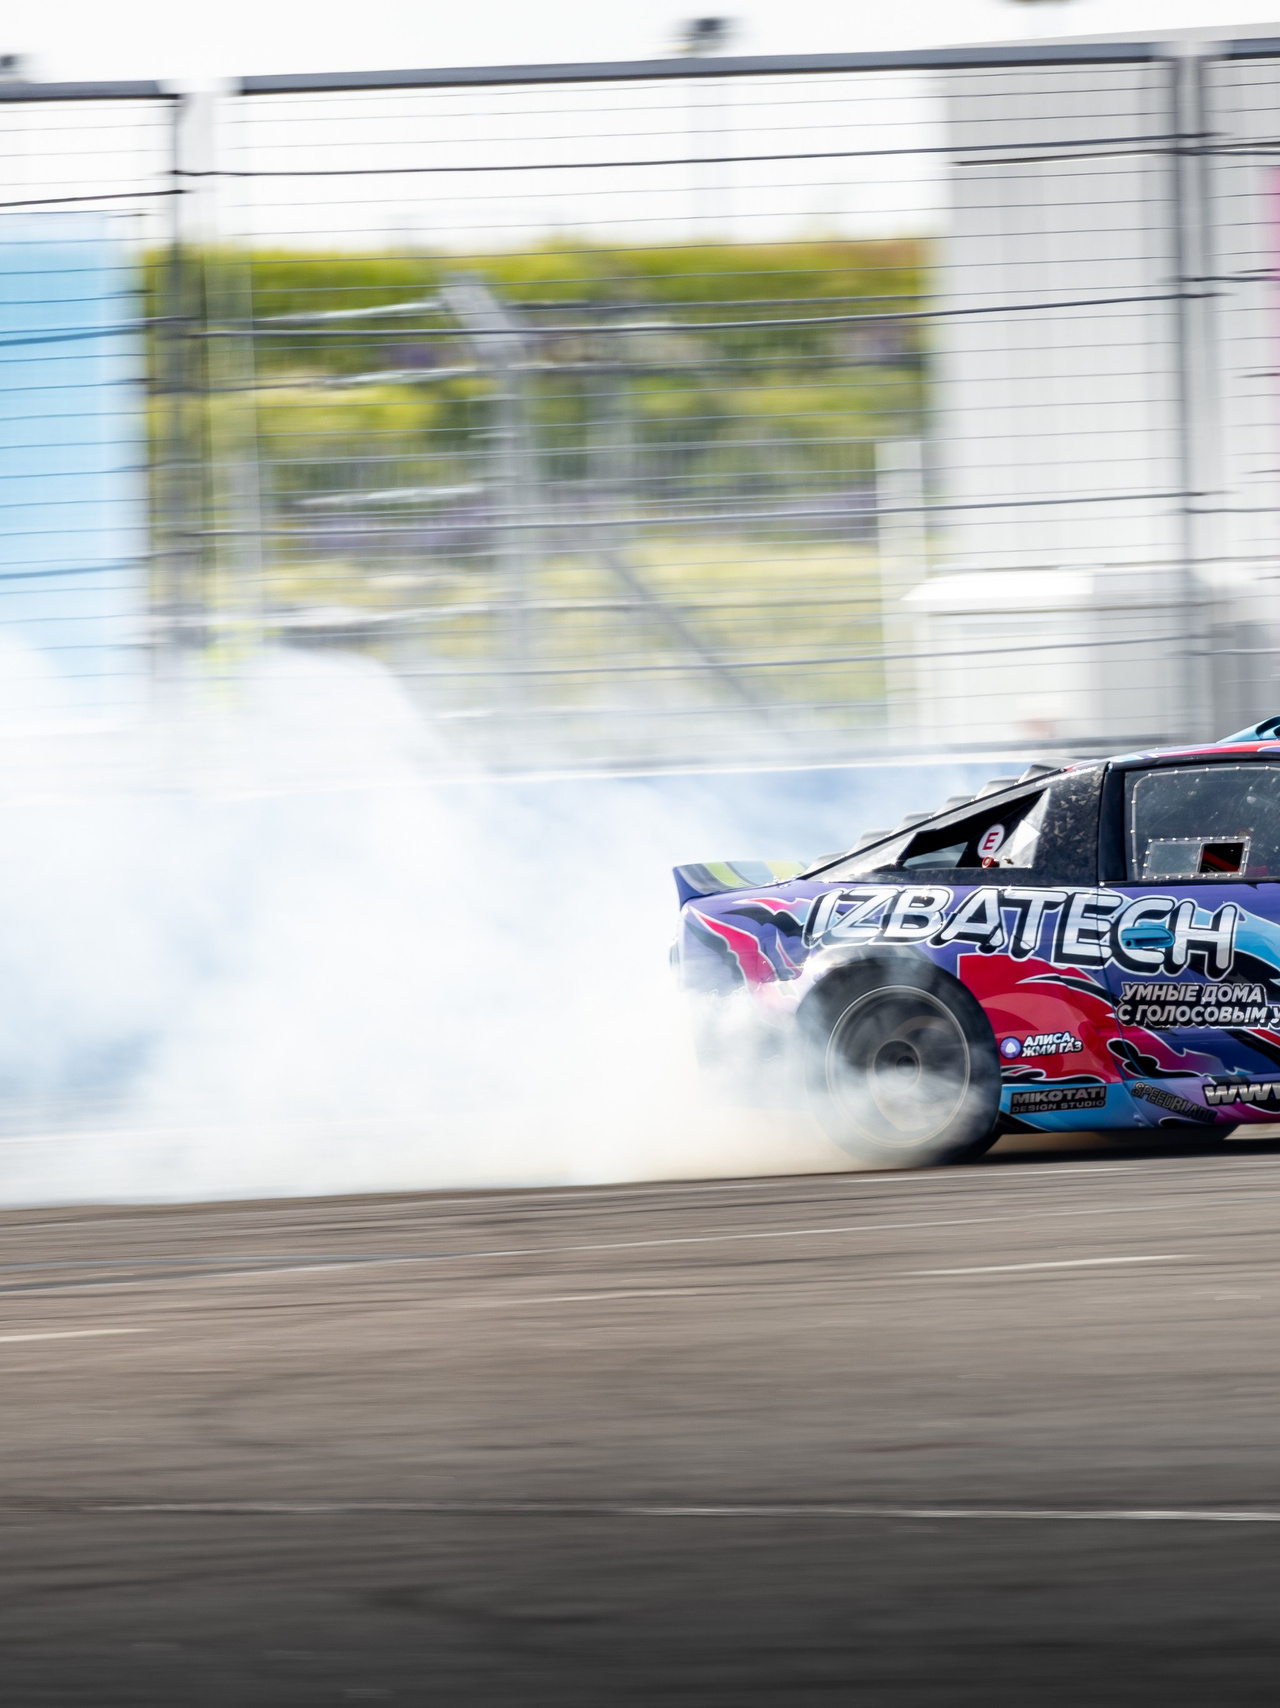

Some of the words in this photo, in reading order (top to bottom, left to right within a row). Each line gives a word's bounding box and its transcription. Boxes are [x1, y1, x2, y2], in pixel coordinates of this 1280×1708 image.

[982, 832, 1000, 850] E
[804, 886, 1242, 977] IZBATECH
[1121, 983, 1199, 1003] УМНЫЕ
[1201, 984, 1264, 1004] ДОМА
[1134, 1003, 1268, 1024] ГОЛОСОВЫМ
[1023, 1032, 1076, 1047] АЛИСА,
[1021, 1043, 1058, 1057] ЖМИ
[1059, 1041, 1083, 1054] ГАЗ
[1012, 1087, 1105, 1104] MIKOTATI
[1011, 1103, 1057, 1114] DESIGN
[1060, 1100, 1105, 1110] STUDIO
